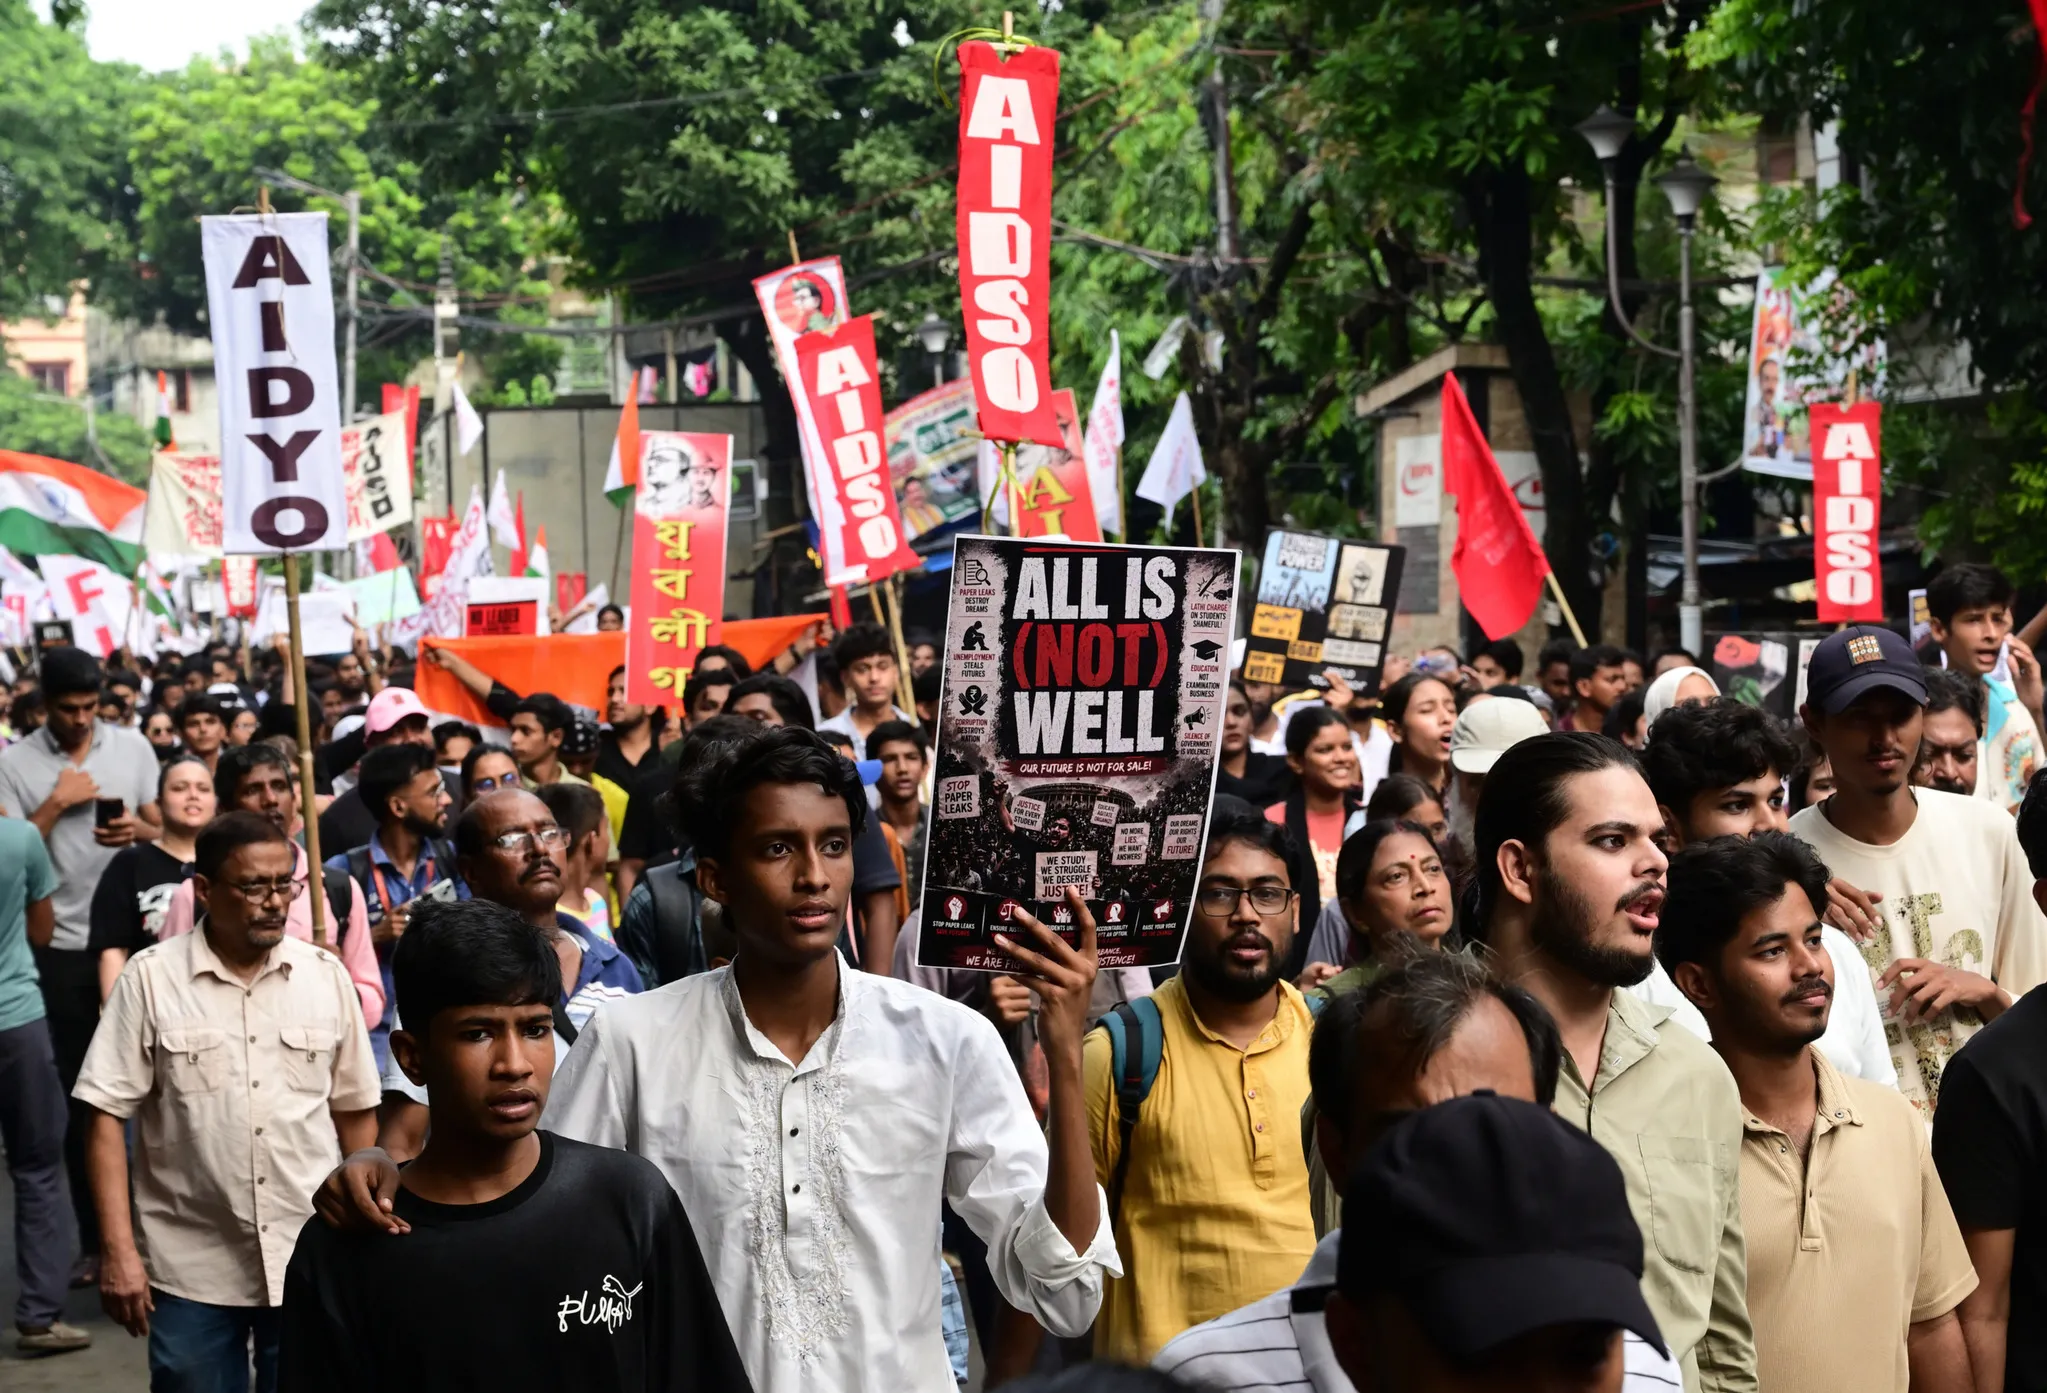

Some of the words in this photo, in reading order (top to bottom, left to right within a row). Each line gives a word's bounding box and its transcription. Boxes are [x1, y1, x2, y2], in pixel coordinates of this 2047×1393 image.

[966, 75, 1040, 413] AIDSO
[232, 235, 328, 549] AIDYO
[817, 345, 897, 559] AIDSO
[1822, 422, 1876, 605] AIDSO
[959, 588, 977, 596] PAPER
[978, 588, 996, 596] LEAKS
[1012, 557, 1109, 620] ALL
[1124, 556, 1176, 620] IS
[965, 597, 990, 605] DESTROY
[965, 605, 989, 613] DREAMS
[1190, 603, 1206, 611] LATHI
[1206, 603, 1228, 612] CHARGE
[1199, 612, 1227, 620] STUDENTS
[1192, 620, 1223, 629] SHAMEFUL!
[953, 653, 996, 661] UNEMPLOYMENT
[1013, 621, 1169, 689] (NOT)
[963, 661, 984, 669] STEALS
[1190, 664, 1219, 673] EDUCATION
[961, 670, 986, 678] FUTURES
[1198, 673, 1210, 681] NOT
[1185, 681, 1220, 690] EXAMINATION
[1189, 690, 1215, 698] BUSINESS
[955, 718, 988, 726] CORRUPTION
[1013, 690, 1165, 755] WELL
[957, 726, 985, 734] DESTROYS
[960, 734, 981, 742] NATION
[1184, 732, 1204, 740] SILENCE
[1204, 732, 1211, 740] OF
[1180, 740, 1213, 748] GOVERNMENT
[1019, 763, 1039, 774] OUR
[1040, 763, 1073, 774] FUTURE
[1076, 763, 1084, 773] IS
[1086, 762, 1106, 773] NOT
[1107, 762, 1125, 773] FOR
[1127, 760, 1152, 771] SALE!
[946, 780, 971, 792] STOP
[944, 791, 973, 803] PAPER
[944, 802, 973, 814] LEAKS
[1016, 799, 1041, 812] JUSTICE
[1013, 807, 1024, 815] FOR
[1024, 809, 1041, 820] EVERY
[1013, 816, 1038, 827] STUDENT
[1129, 827, 1144, 835] MORE
[1169, 828, 1179, 836] OUR
[1166, 845, 1195, 854] FUTURE!
[1046, 856, 1059, 865] WE
[1061, 855, 1087, 865] STUDY
[1040, 866, 1052, 875] WE
[1054, 865, 1091, 874] STRUGGLE
[1042, 875, 1054, 885] WE
[1056, 874, 1089, 884] DESERVE
[1042, 884, 1088, 897] JUSTE!
[932, 920, 945, 928] STOP
[945, 921, 960, 929] PAPER
[960, 922, 975, 930] LEAKS
[989, 924, 1008, 932] ENSURE
[986, 948, 996, 956] WE
[965, 955, 982, 966] WE
[983, 957, 1002, 968] ARE
